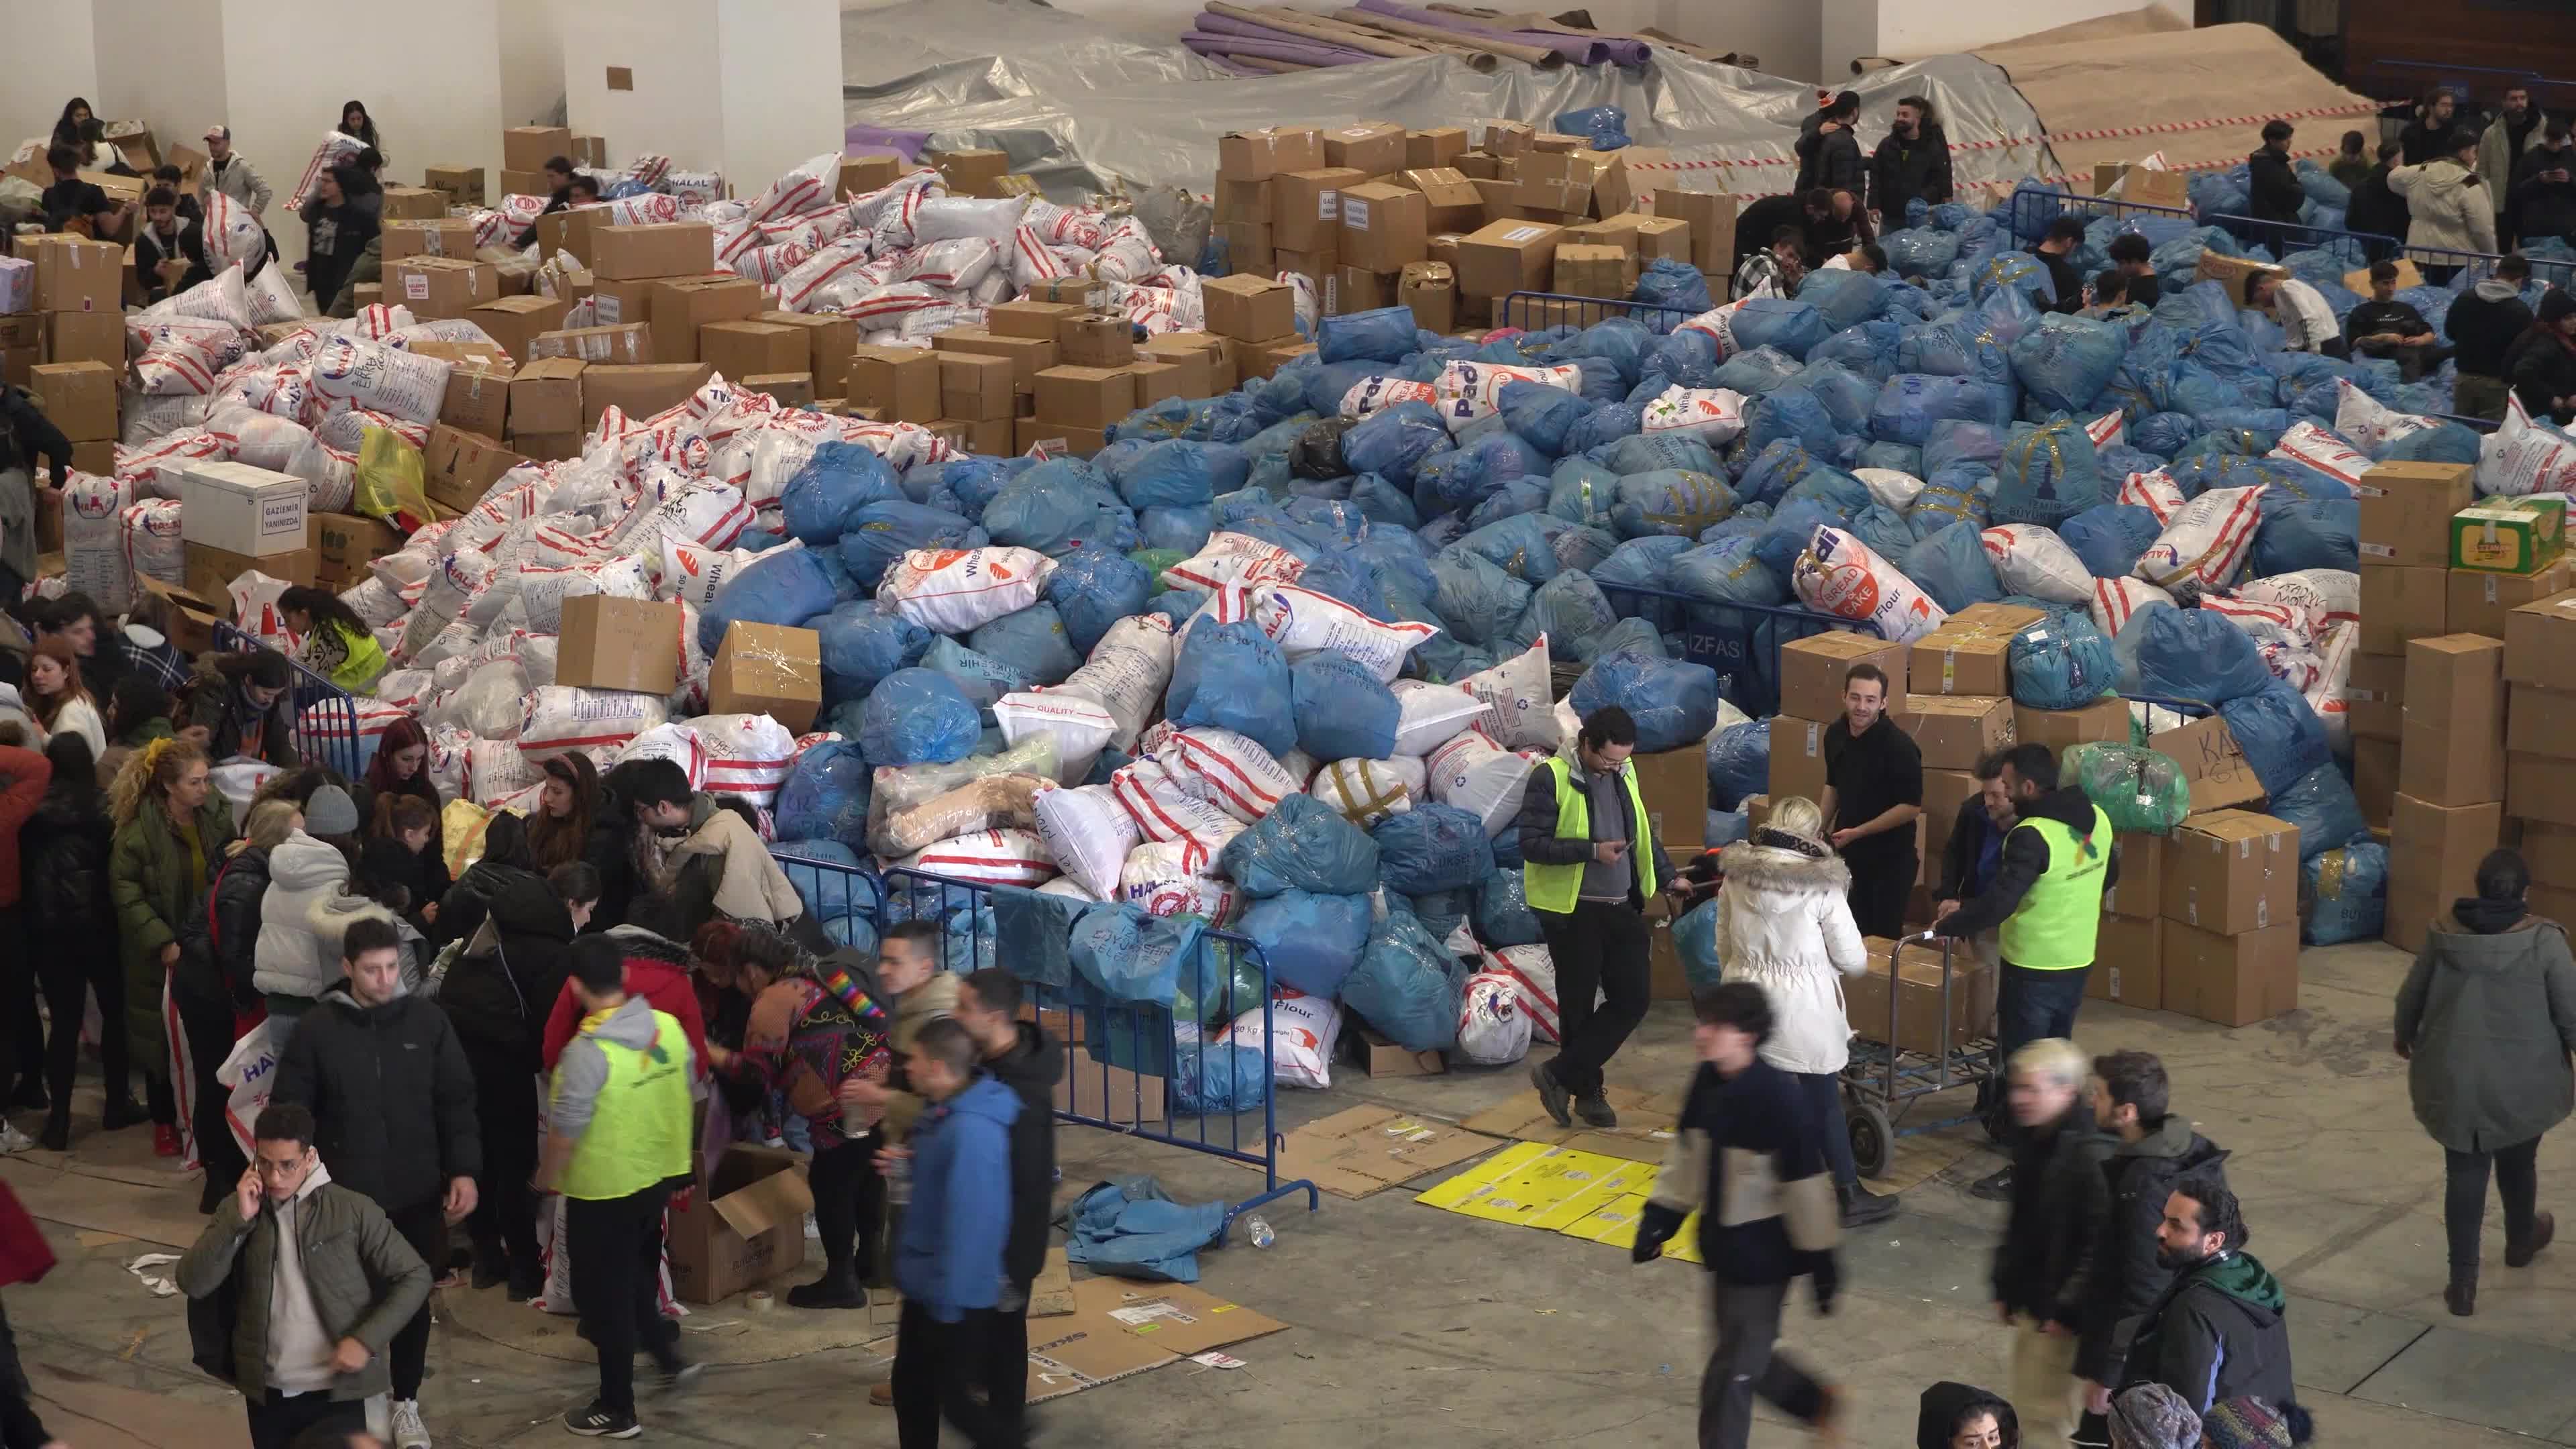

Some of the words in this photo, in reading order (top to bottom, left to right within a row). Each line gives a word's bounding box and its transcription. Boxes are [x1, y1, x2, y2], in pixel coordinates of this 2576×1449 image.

[672, 178, 708, 188] HALAL
[1679, 390, 1691, 415] Whea
[264, 517, 299, 529] YANINIZDA
[1825, 567, 1858, 602] BREAD
[1846, 588, 1856, 599] &
[1843, 585, 1874, 616] CAKE
[1874, 587, 1901, 619] Flour
[1036, 705, 1074, 715] QUALITY
[1275, 1001, 1314, 1020] Flour
[1246, 1025, 1258, 1036] kg
[1028, 1332, 1087, 1354] SKEC
